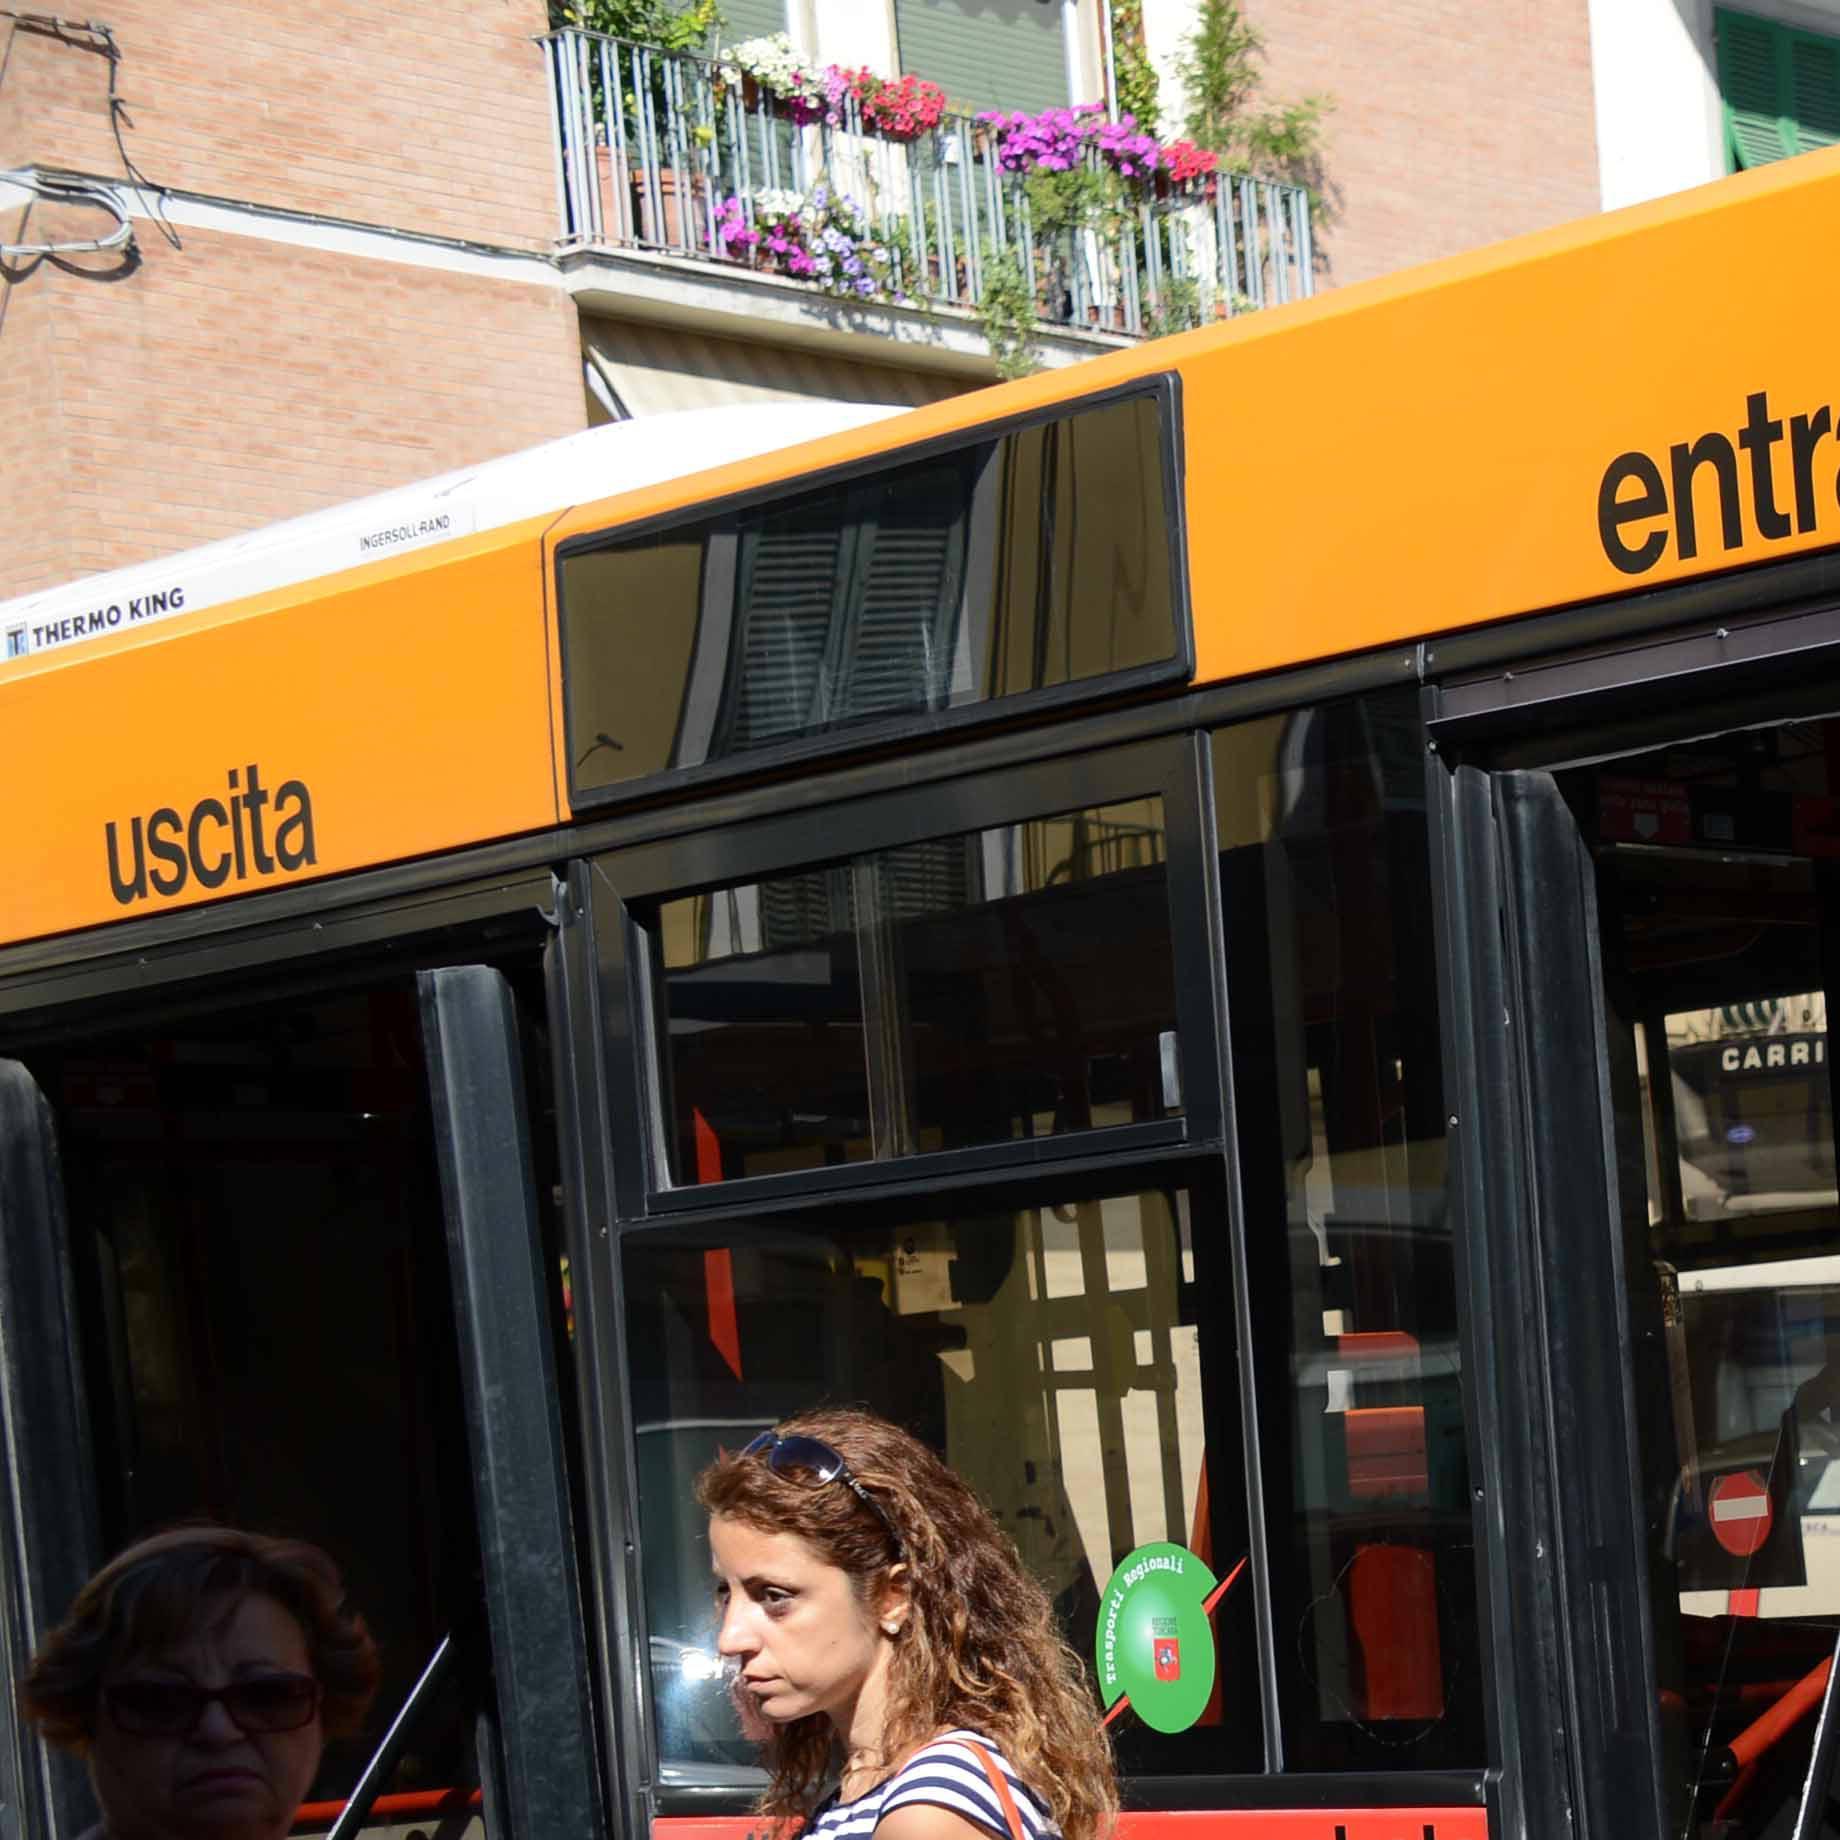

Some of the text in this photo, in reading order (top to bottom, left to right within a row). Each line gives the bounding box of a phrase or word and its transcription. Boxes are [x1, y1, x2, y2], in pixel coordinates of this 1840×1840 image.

[32, 586, 185, 648] THERMO KING
[105, 763, 317, 905] uscita
[1122, 1555, 1185, 1588] Regionali
[1104, 1588, 1125, 1685] Trasporti
